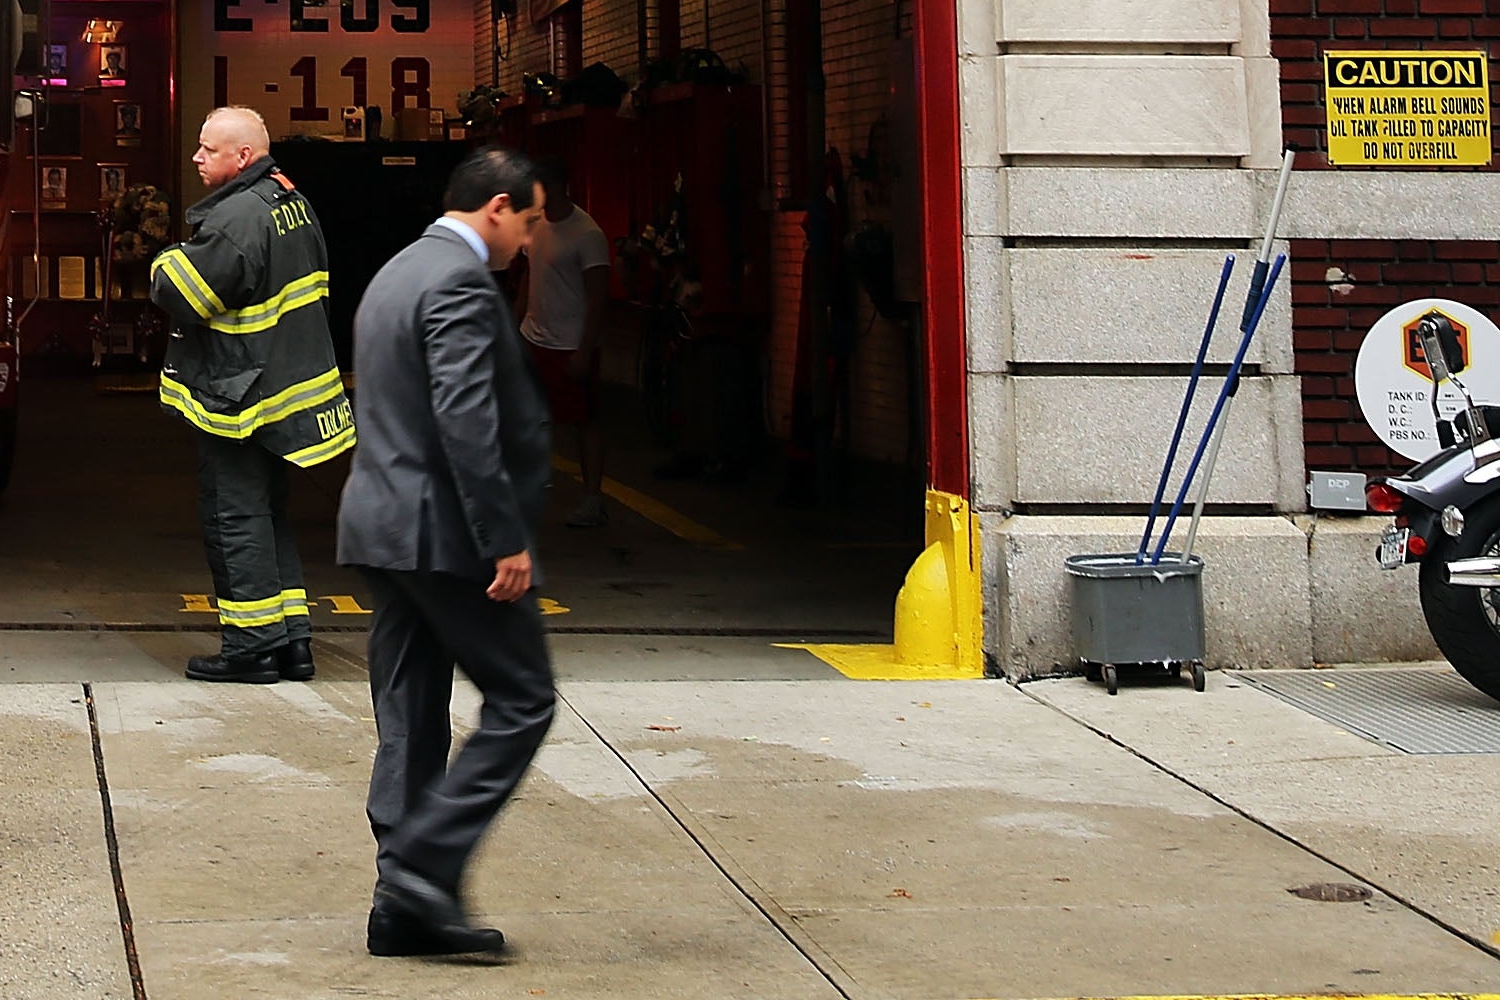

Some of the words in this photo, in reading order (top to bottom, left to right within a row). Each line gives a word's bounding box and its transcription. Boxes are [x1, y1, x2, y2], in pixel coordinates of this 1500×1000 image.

[1335, 60, 1476, 85] CAUTION
[1332, 97, 1365, 115] WHEN
[1369, 97, 1407, 115] ALARM
[1411, 97, 1437, 115] BELL
[1441, 97, 1485, 115] SOUNDS
[1351, 119, 1379, 137] TANK
[1421, 119, 1434, 137] TO
[1438, 119, 1488, 137] CAPACITY
[1363, 142, 1378, 159] DO
[1383, 142, 1404, 159] NOT
[1408, 142, 1458, 160] OVERFILL
[1388, 391, 1413, 401] TANK
[1415, 391, 1428, 402] ID:
